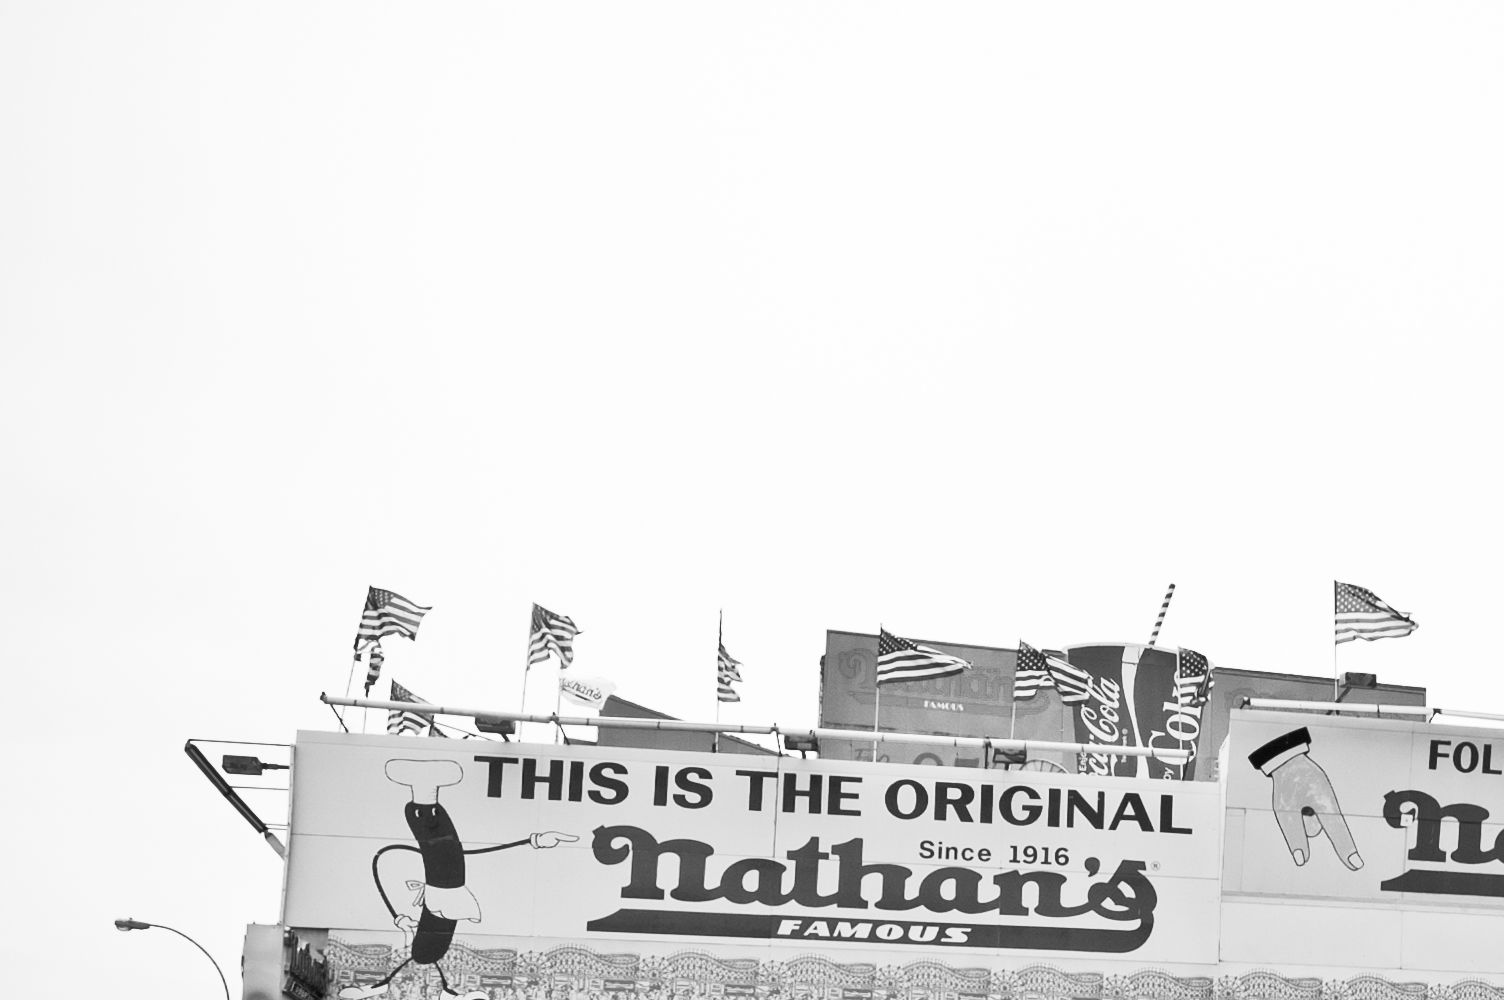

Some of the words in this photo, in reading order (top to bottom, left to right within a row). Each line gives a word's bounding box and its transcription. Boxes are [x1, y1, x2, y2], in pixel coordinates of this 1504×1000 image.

[474, 755, 629, 806] THIS
[653, 765, 713, 809] IS
[736, 769, 863, 817] THE
[884, 778, 1193, 835] ORIGINAL
[918, 840, 992, 863] Since
[1008, 845, 1070, 867] 1916
[776, 919, 972, 943] FAMOUS
